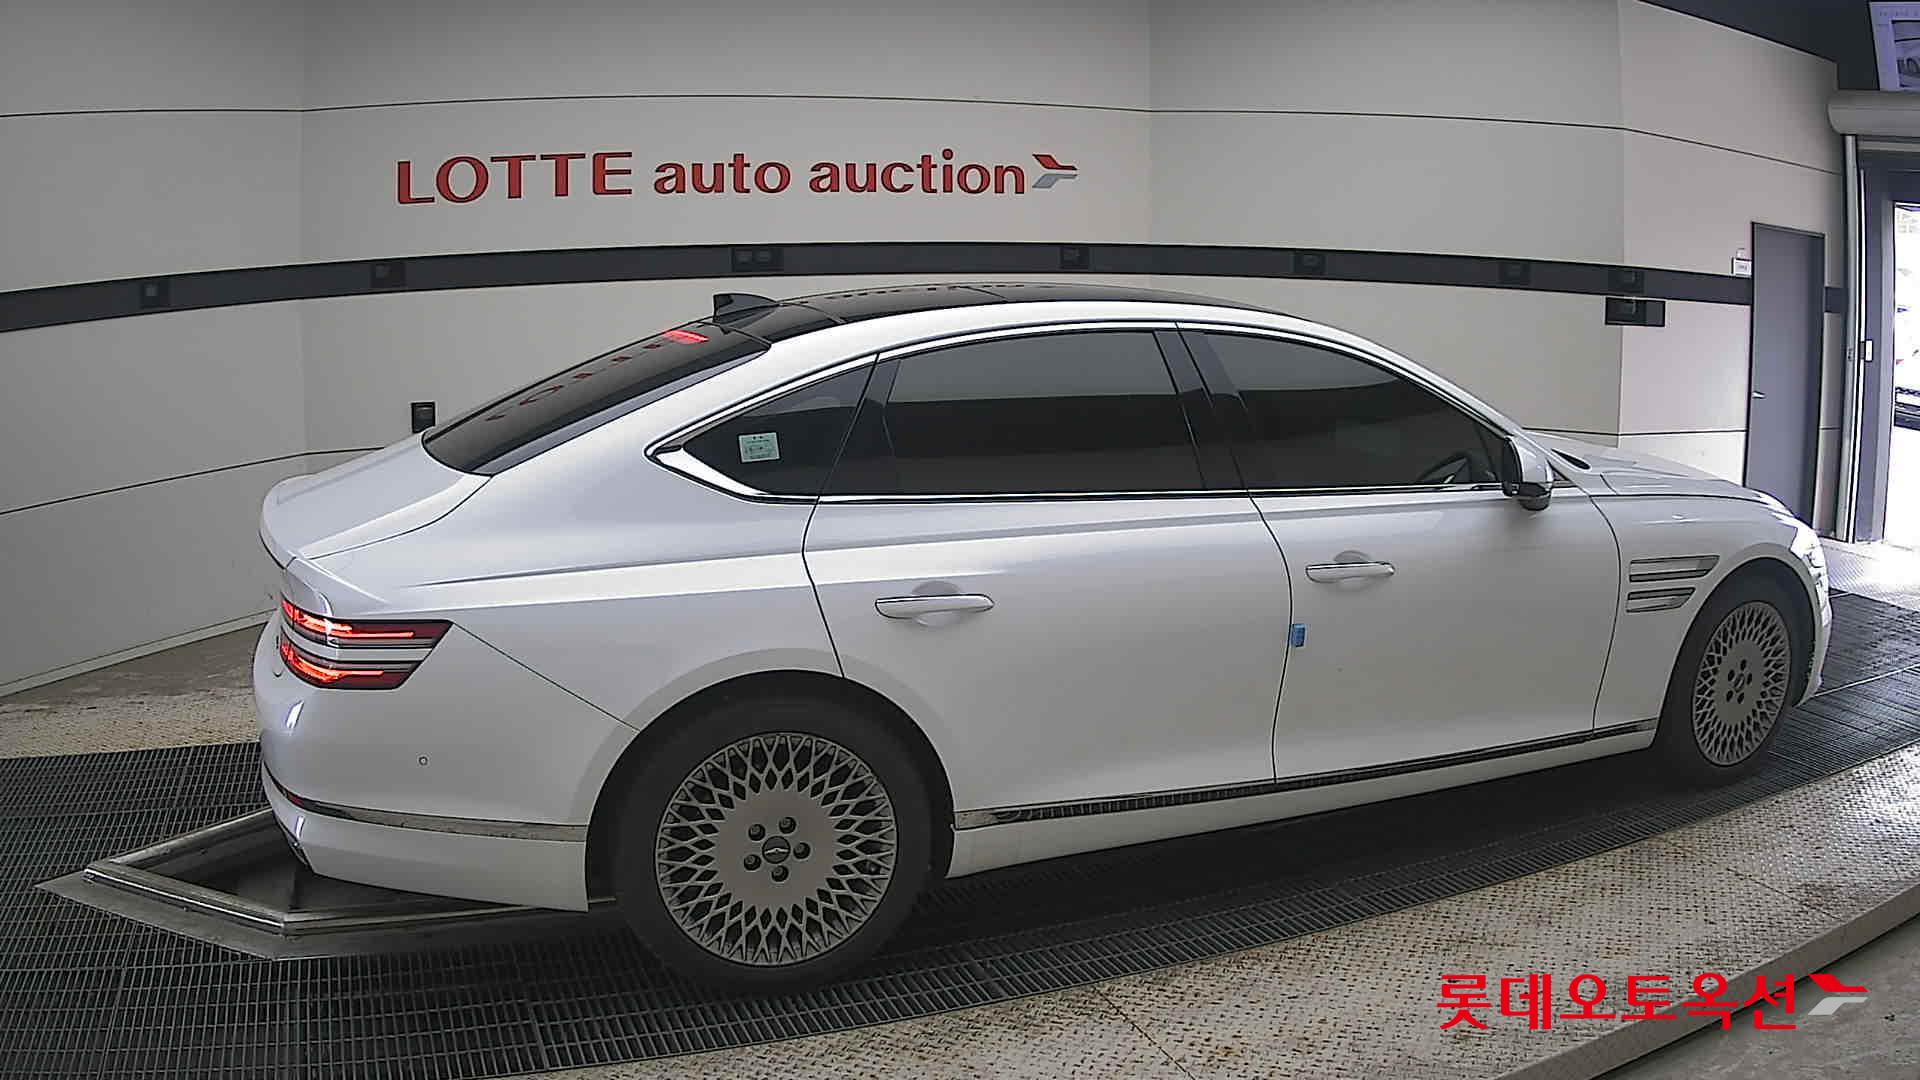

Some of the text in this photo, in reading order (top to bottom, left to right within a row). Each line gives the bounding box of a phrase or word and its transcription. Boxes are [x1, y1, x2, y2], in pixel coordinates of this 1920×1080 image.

[397, 148, 1025, 204] LOTTE auto auction
